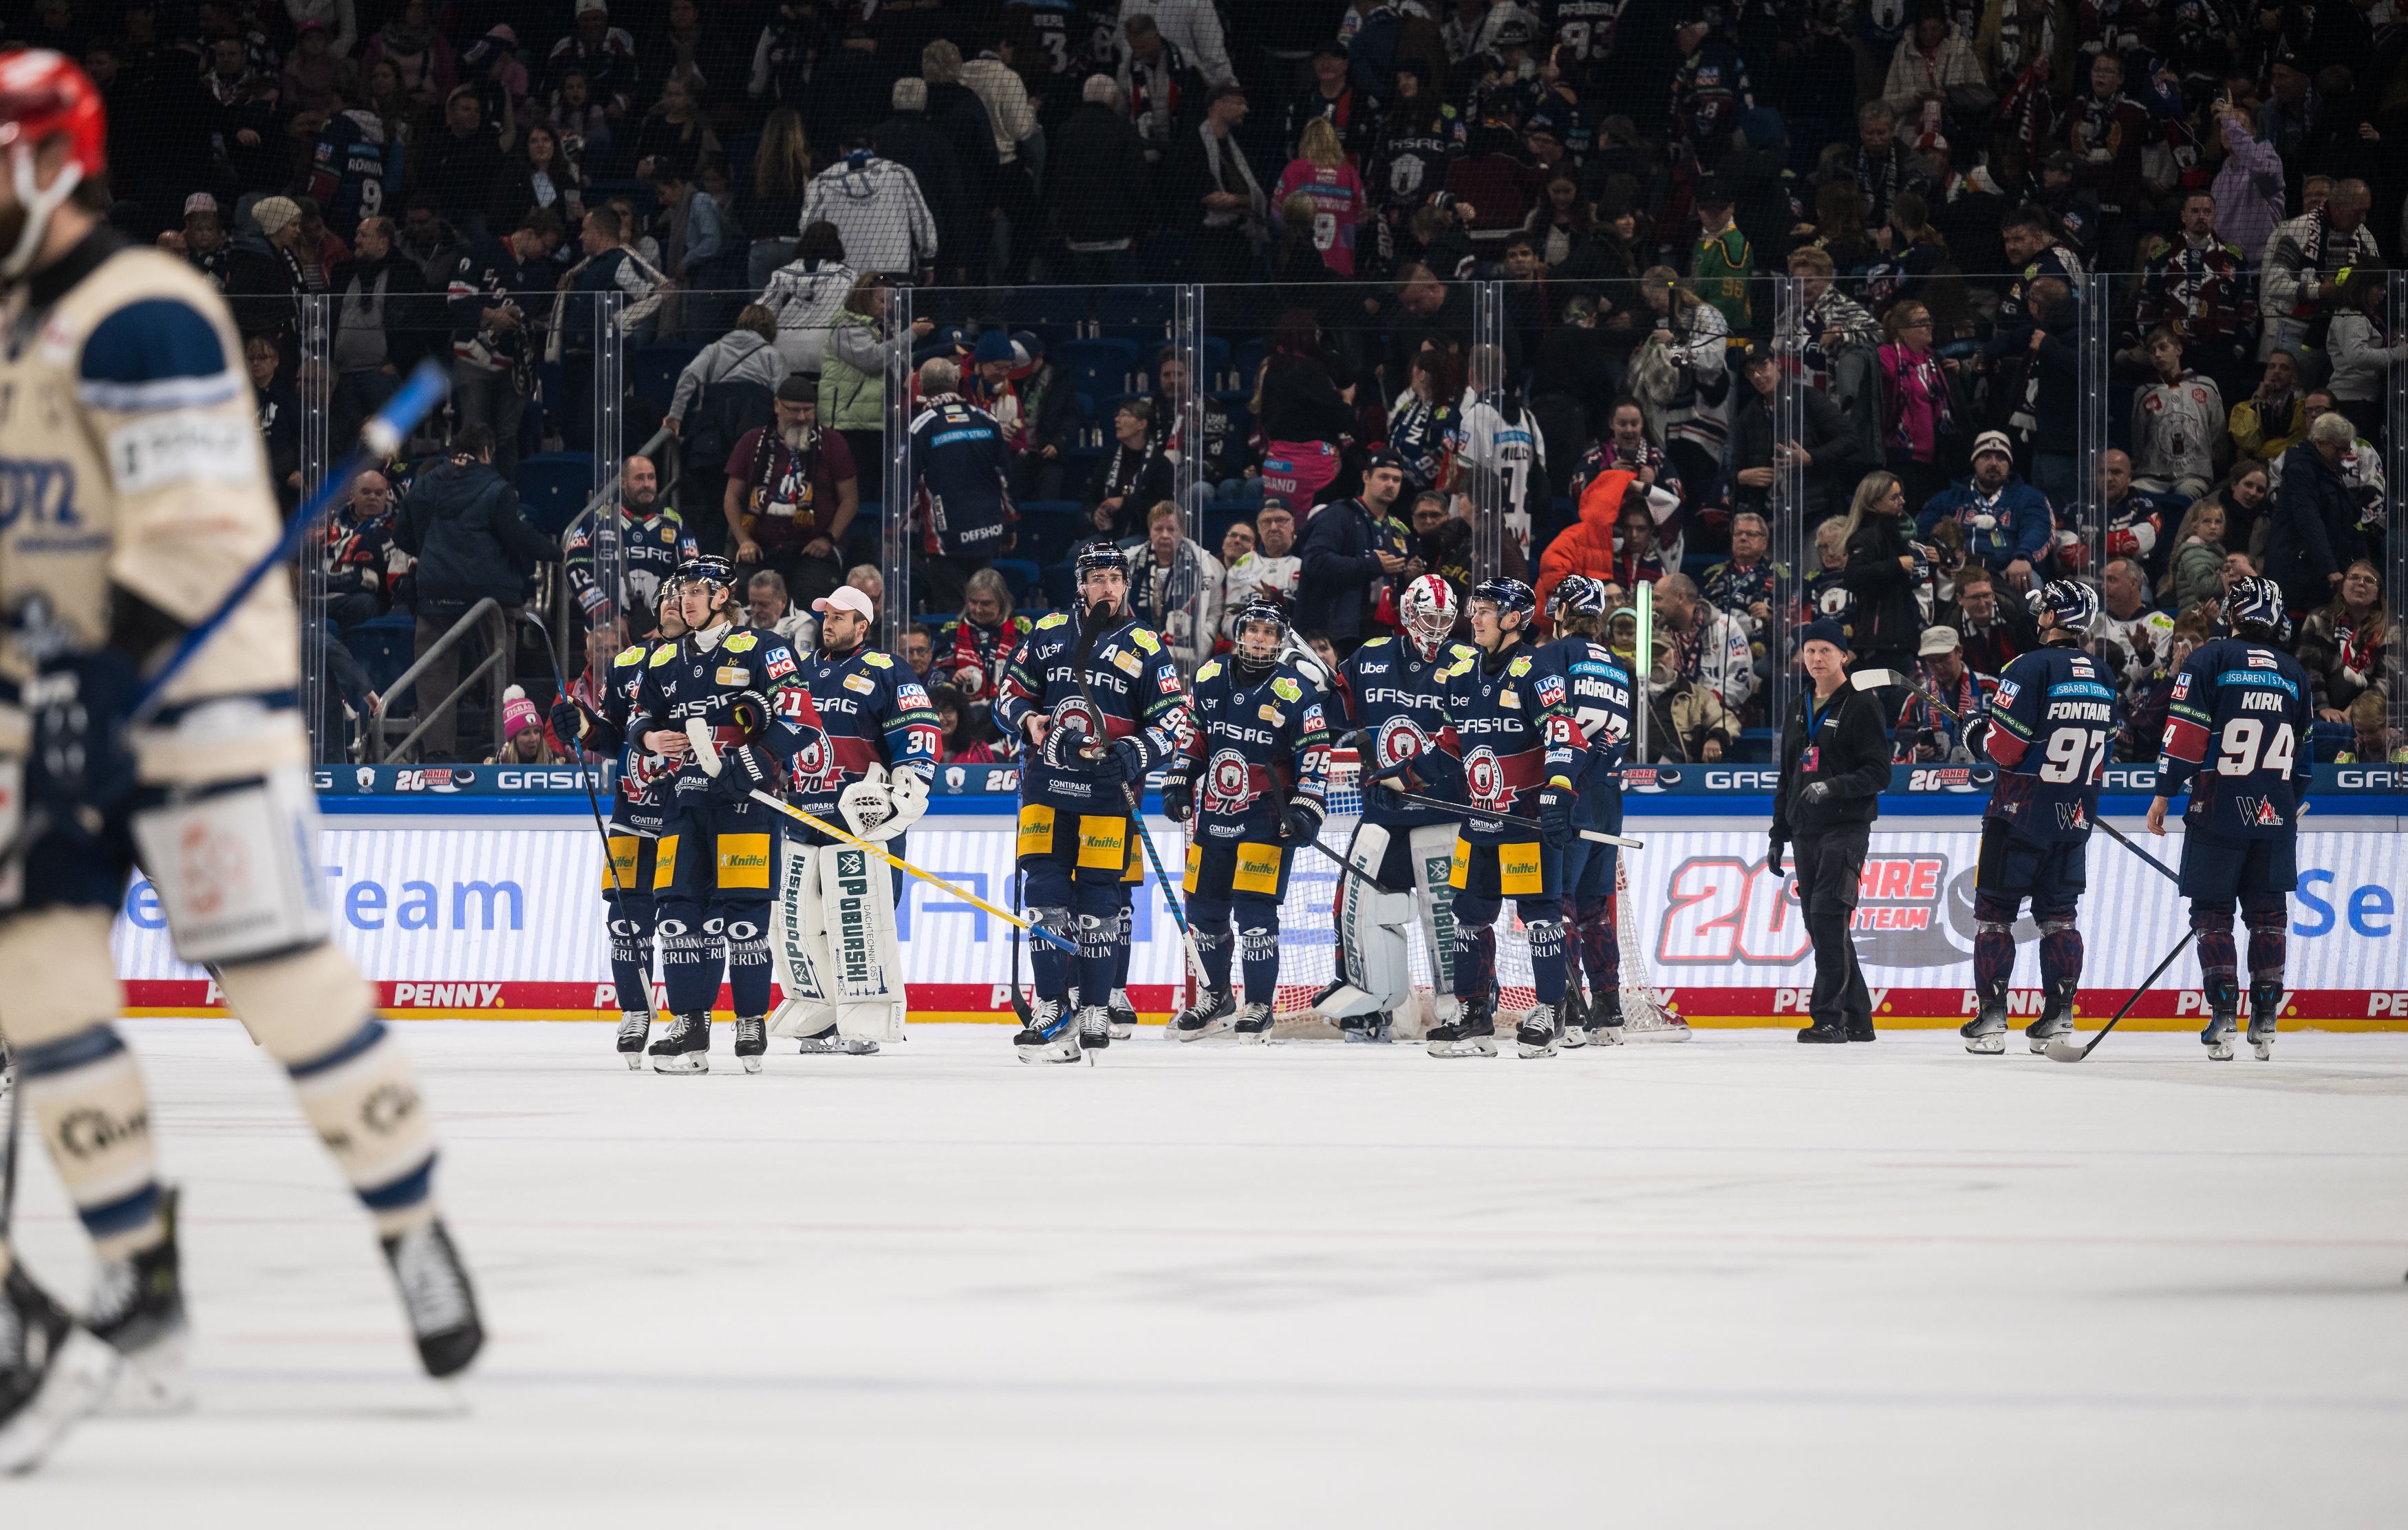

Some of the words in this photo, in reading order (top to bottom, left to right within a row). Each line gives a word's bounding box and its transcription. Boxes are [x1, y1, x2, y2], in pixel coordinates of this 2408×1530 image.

[1388, 138, 1445, 153] ASAG
[359, 177, 383, 220] 9
[1415, 455, 1442, 480] 93
[2244, 616, 2273, 626] STADLER
[727, 636, 753, 649] Karls
[767, 648, 791, 665] LIQ
[1035, 643, 1064, 660] Uber
[1099, 643, 1119, 662] A
[768, 659, 795, 678] MO
[1158, 666, 1176, 680] LIQ
[1359, 662, 1389, 674] Uber
[1575, 663, 1606, 675] ISBÄREN
[1537, 675, 1565, 694] LIQUI
[2225, 671, 2266, 683] EISBÄREN
[660, 680, 677, 698] ber
[1161, 680, 1181, 693] MO
[1273, 680, 1298, 701] Karls
[1573, 676, 1629, 709] HÖRDLER
[2054, 684, 2088, 695] ISBÄREN
[2093, 685, 2111, 697] STRO
[773, 691, 802, 717] 21
[811, 697, 859, 715] SAG
[900, 695, 932, 710] MOLY
[1155, 700, 1168, 709] LIGO
[1450, 693, 1471, 707] ber
[2241, 691, 2283, 713] KIRK
[1304, 703, 1323, 719] LIQ
[2047, 702, 2111, 722] FONTAINE
[2192, 709, 2206, 720] LIGO
[891, 715, 906, 726] LIGO
[1159, 707, 1187, 740] 92
[1304, 718, 1326, 733] MO
[2003, 715, 2016, 725] LIGO
[2015, 723, 2028, 734] LIGO
[1385, 723, 1397, 735] UND
[2162, 724, 2178, 748] 4
[906, 730, 936, 755] 30
[1179, 726, 1196, 749] 5
[1546, 750, 1573, 760] eiffert
[2039, 726, 2107, 786] 97
[2217, 718, 2295, 781] 94
[801, 764, 821, 774] BERLIN
[914, 763, 936, 775] eiffert
[1300, 751, 1331, 775] 95
[395, 770, 426, 790] 20
[421, 768, 453, 778] JAHRE
[497, 771, 601, 790] GASA
[985, 769, 1018, 791] 20
[1161, 775, 1187, 788] RIOR
[1624, 768, 1658, 779] JAHRE
[1705, 771, 1781, 789] GAS
[1909, 769, 1941, 791] 20
[1937, 768, 1970, 778] JAHRE
[2337, 771, 2408, 788] GAS
[674, 775, 709, 792] NTIPARK
[799, 775, 824, 795] 70
[1049, 779, 1092, 792] CONTIPARK
[1494, 801, 1506, 809] 2024
[630, 815, 663, 826] CONTIPA
[1209, 823, 1246, 834] CONTIPARK
[1086, 835, 1123, 848] Knittel
[608, 855, 636, 868] nittel
[729, 854, 768, 868] Knittel
[1185, 861, 1198, 874] ittel
[1243, 861, 1278, 875] Knittel
[1452, 857, 1468, 870] nittel
[1506, 862, 1538, 874] Knittel
[319, 865, 524, 931] eam
[1344, 854, 1368, 953] POBURSI
[2292, 868, 2394, 937] Se
[785, 854, 806, 959] POBURSKI
[1659, 861, 1811, 961] 20
[838, 878, 869, 982] POBURSKI
[1079, 930, 1118, 945] ELBANK
[1529, 927, 1567, 943] ELBANK
[660, 938, 705, 949] ELBANK
[863, 905, 877, 964] DACHTECHNIK
[870, 965, 879, 982] OST
[1029, 938, 1057, 953] RLIN
[1243, 935, 1278, 948] ELBANK
[611, 947, 649, 962] BERLN
[662, 951, 700, 967] BERLIN
[729, 952, 768, 966] BERLIN
